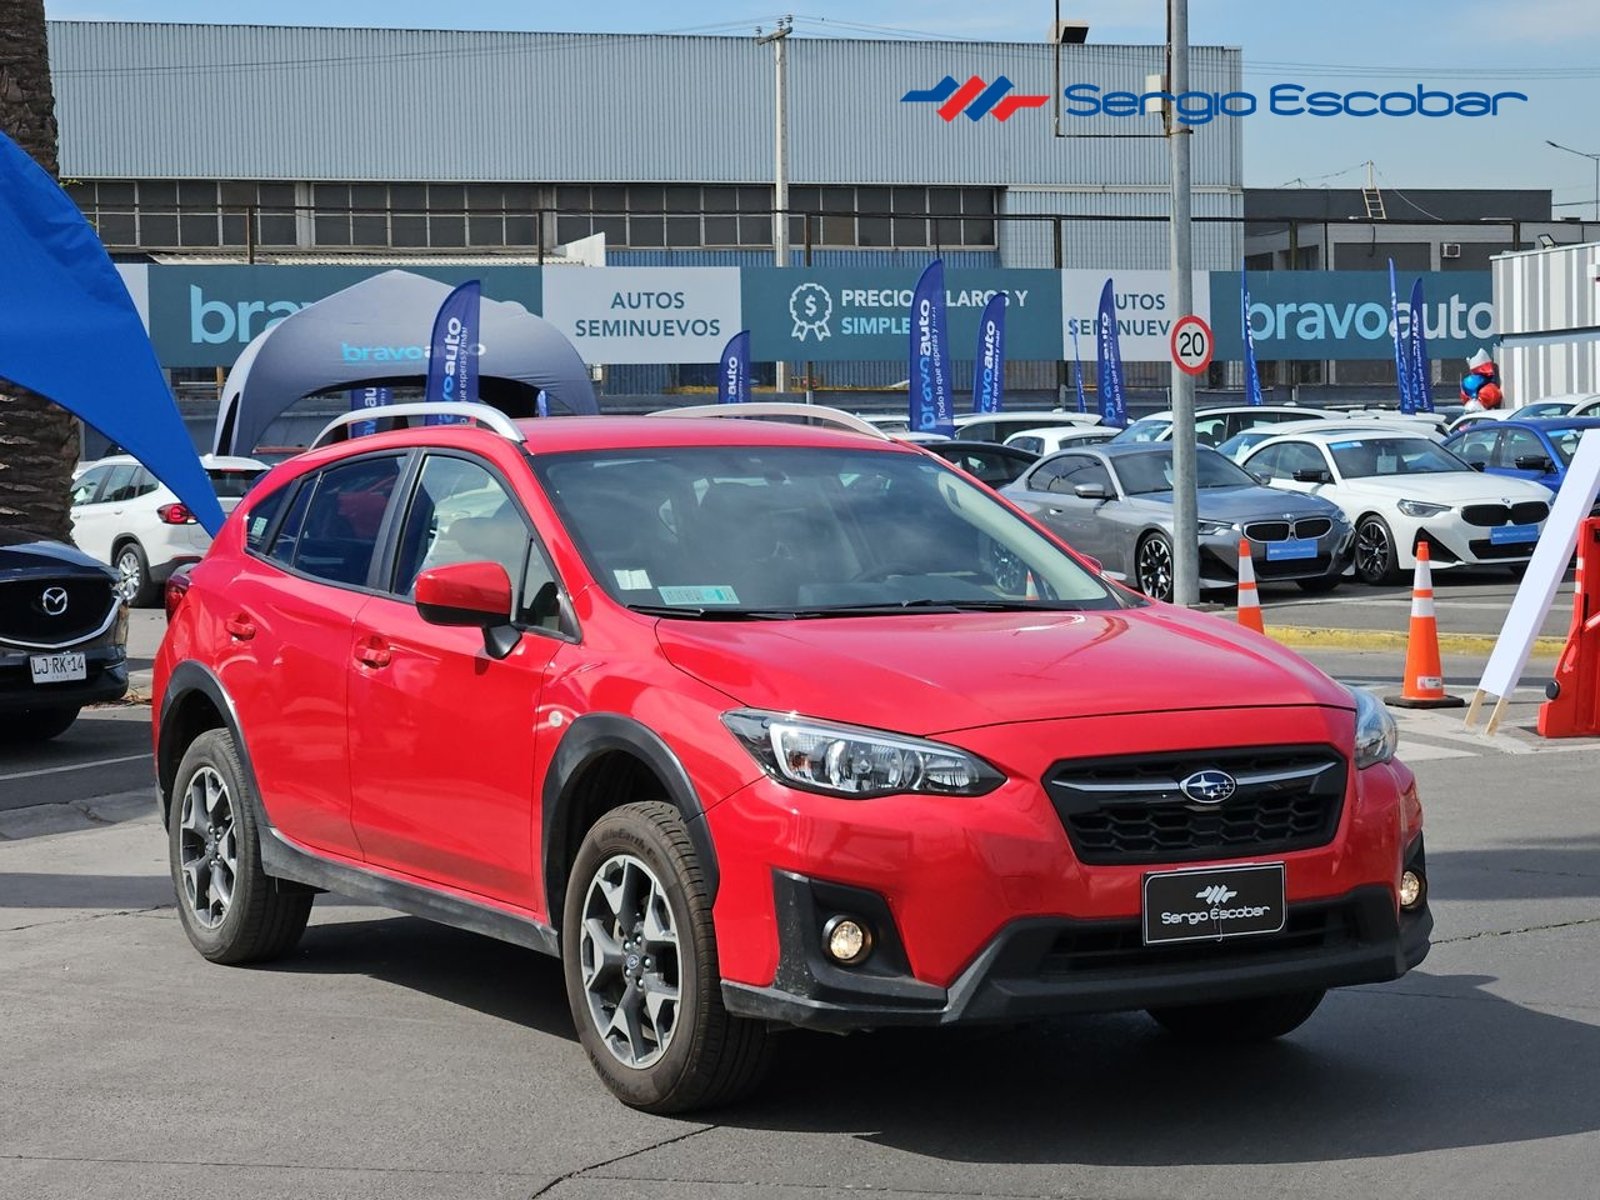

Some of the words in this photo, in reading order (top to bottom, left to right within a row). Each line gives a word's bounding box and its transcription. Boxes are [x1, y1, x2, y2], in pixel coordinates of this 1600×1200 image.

[611, 292, 685, 309] AUTOS
[841, 289, 914, 307] PRECIO
[945, 289, 1010, 307] LARO
[1014, 290, 1029, 307] Y
[1115, 294, 1165, 310] UTOS
[1241, 288, 1494, 341] bravoauto
[575, 319, 721, 337] SEMINUEVOS
[841, 317, 910, 335] SIMPLE
[1068, 319, 1170, 336] SENUEV
[341, 342, 486, 361] bravoo
[1179, 331, 1205, 357] 20
[919, 299, 936, 430] bravoauto
[980, 320, 996, 413] ravoauto
[935, 371, 944, 385] que
[1210, 906, 1271, 920] Escobar
